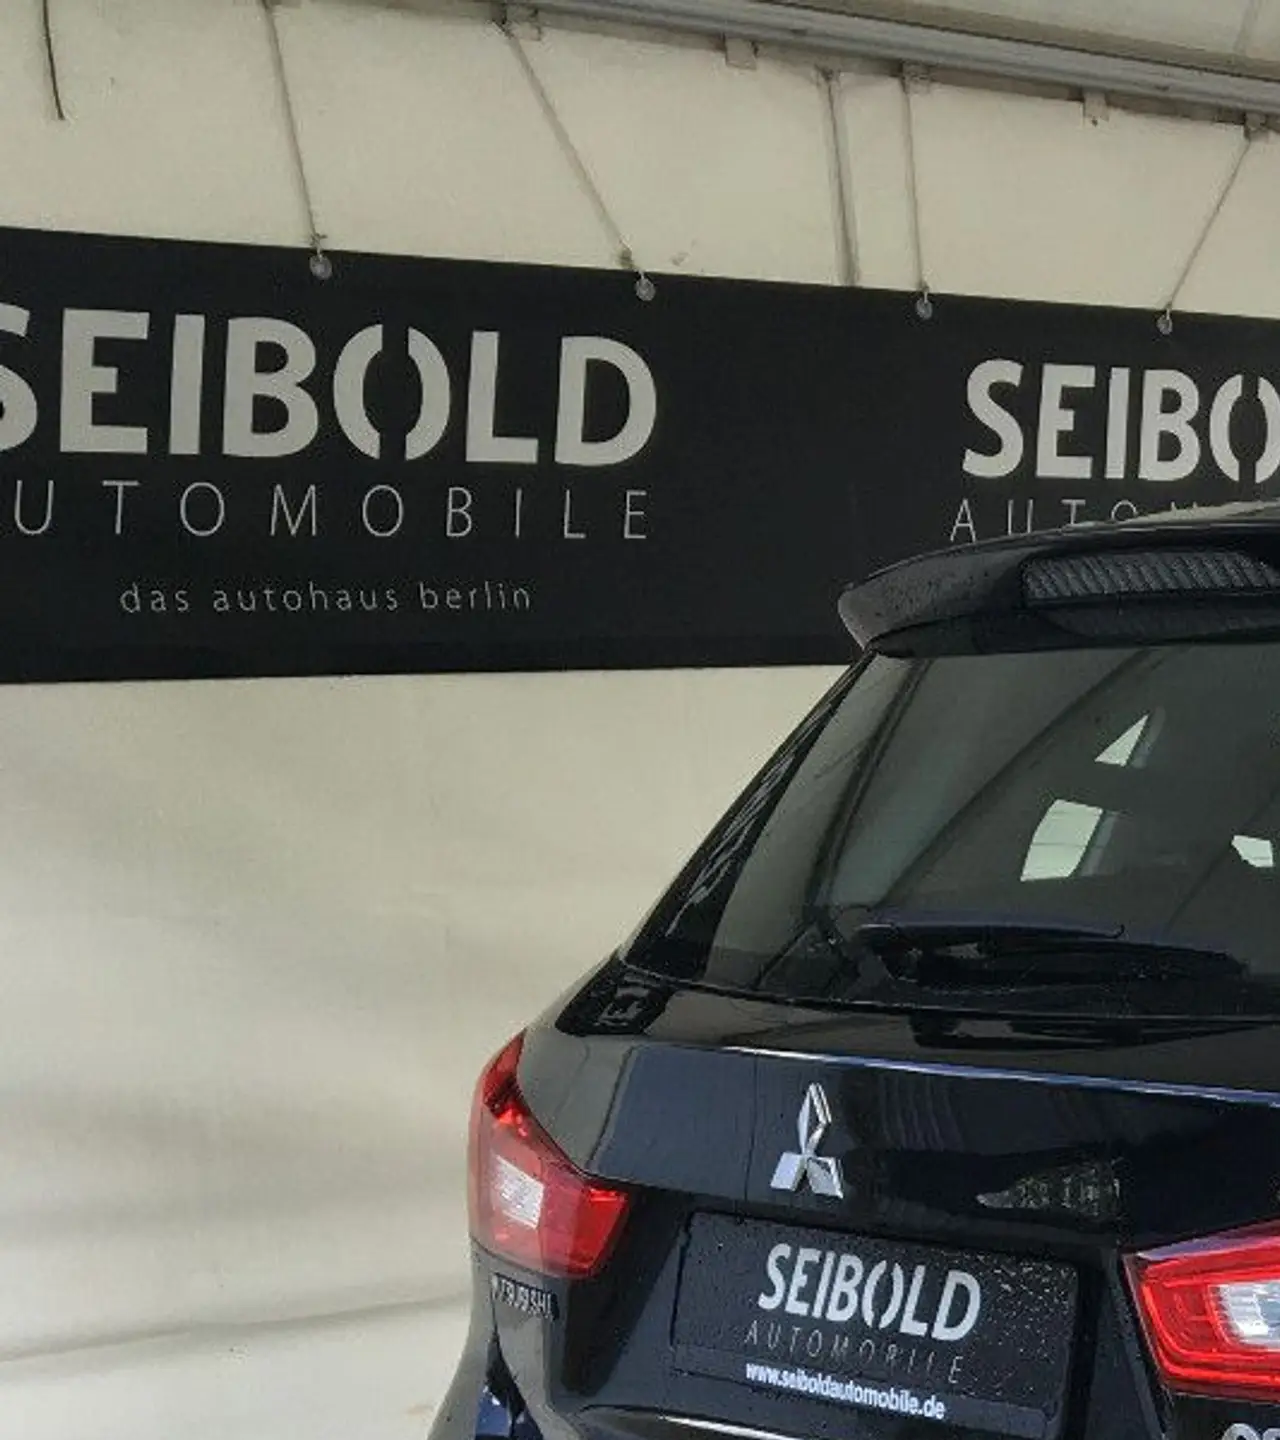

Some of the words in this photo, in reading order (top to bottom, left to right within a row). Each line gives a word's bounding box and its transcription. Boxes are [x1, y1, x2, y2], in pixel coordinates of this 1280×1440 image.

[119, 581, 190, 614] das
[213, 580, 399, 613] autohaus
[418, 579, 531, 611] berlin
[758, 1243, 981, 1341] SEIBOLD
[745, 1362, 946, 1420] www.seiboldautomobile.de
